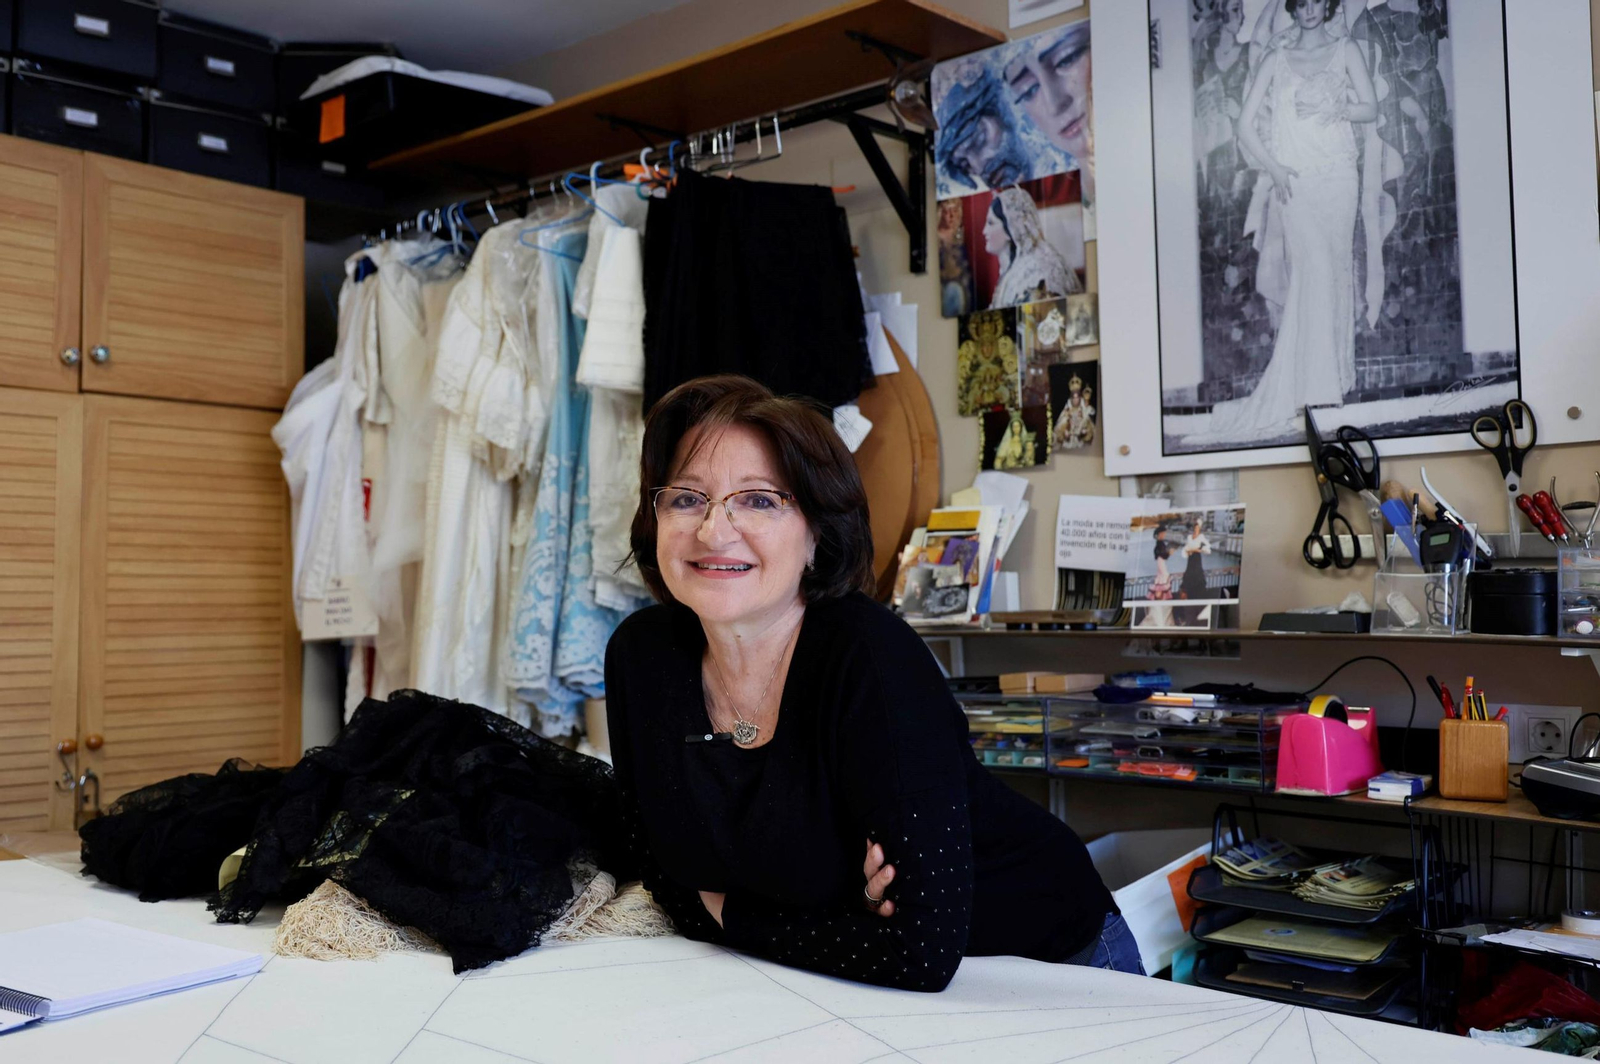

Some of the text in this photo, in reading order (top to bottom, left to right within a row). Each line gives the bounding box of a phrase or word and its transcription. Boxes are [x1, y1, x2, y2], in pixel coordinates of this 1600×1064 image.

[1061, 519, 1070, 527] La
[1072, 520, 1093, 528] moda
[1061, 528, 1086, 538] 40.000
[1089, 531, 1107, 539] años
[1108, 532, 1123, 540] con
[1097, 541, 1107, 550] de
[1109, 542, 1116, 550] la
[1118, 544, 1129, 553] ag
[1059, 550, 1072, 559] ojo
